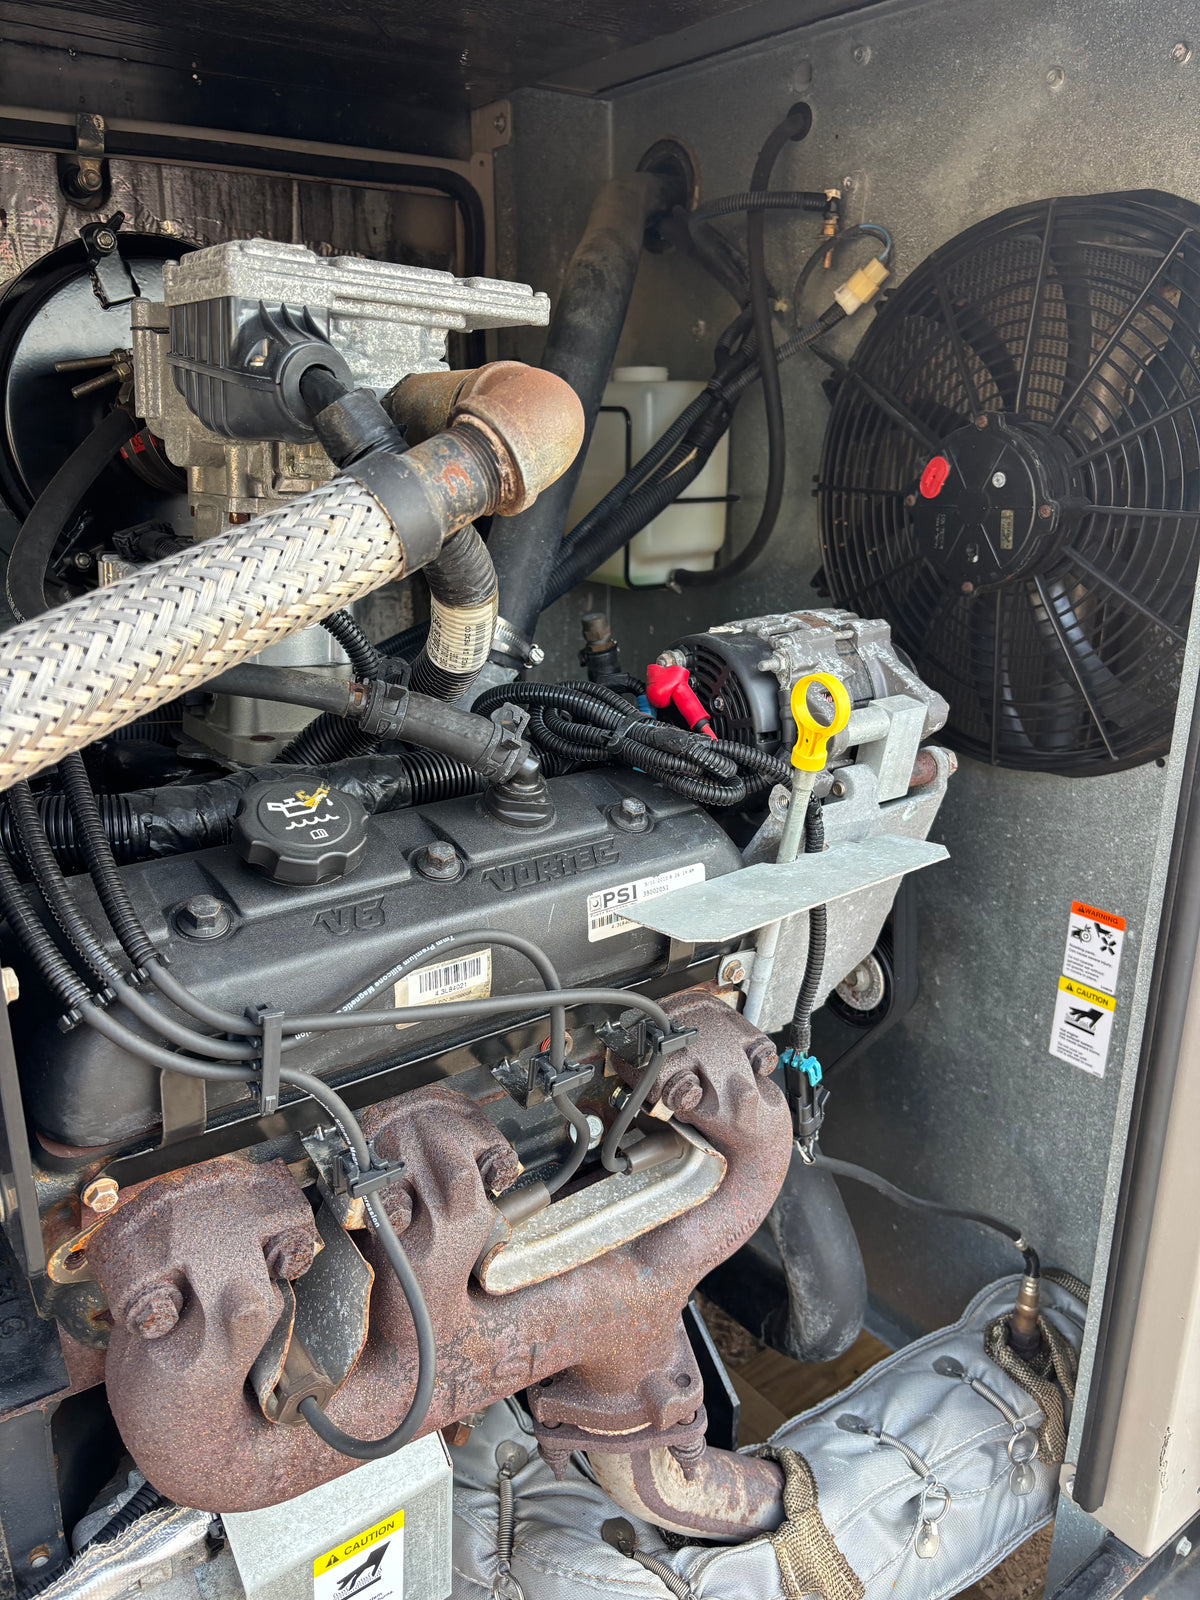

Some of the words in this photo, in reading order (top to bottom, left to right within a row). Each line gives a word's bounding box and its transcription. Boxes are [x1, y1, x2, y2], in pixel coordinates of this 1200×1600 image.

[480, 836, 620, 893] VORTEC
[602, 884, 638, 909] PSI
[312, 893, 386, 935] V6
[1084, 908, 1119, 924] WARNING
[435, 935, 455, 947] 7mm
[402, 944, 436, 965] Premium
[374, 964, 403, 987] Silicone
[341, 986, 376, 1012] Magnetic
[1076, 987, 1109, 1006] CAUTION
[344, 1521, 395, 1556] CAUTION
